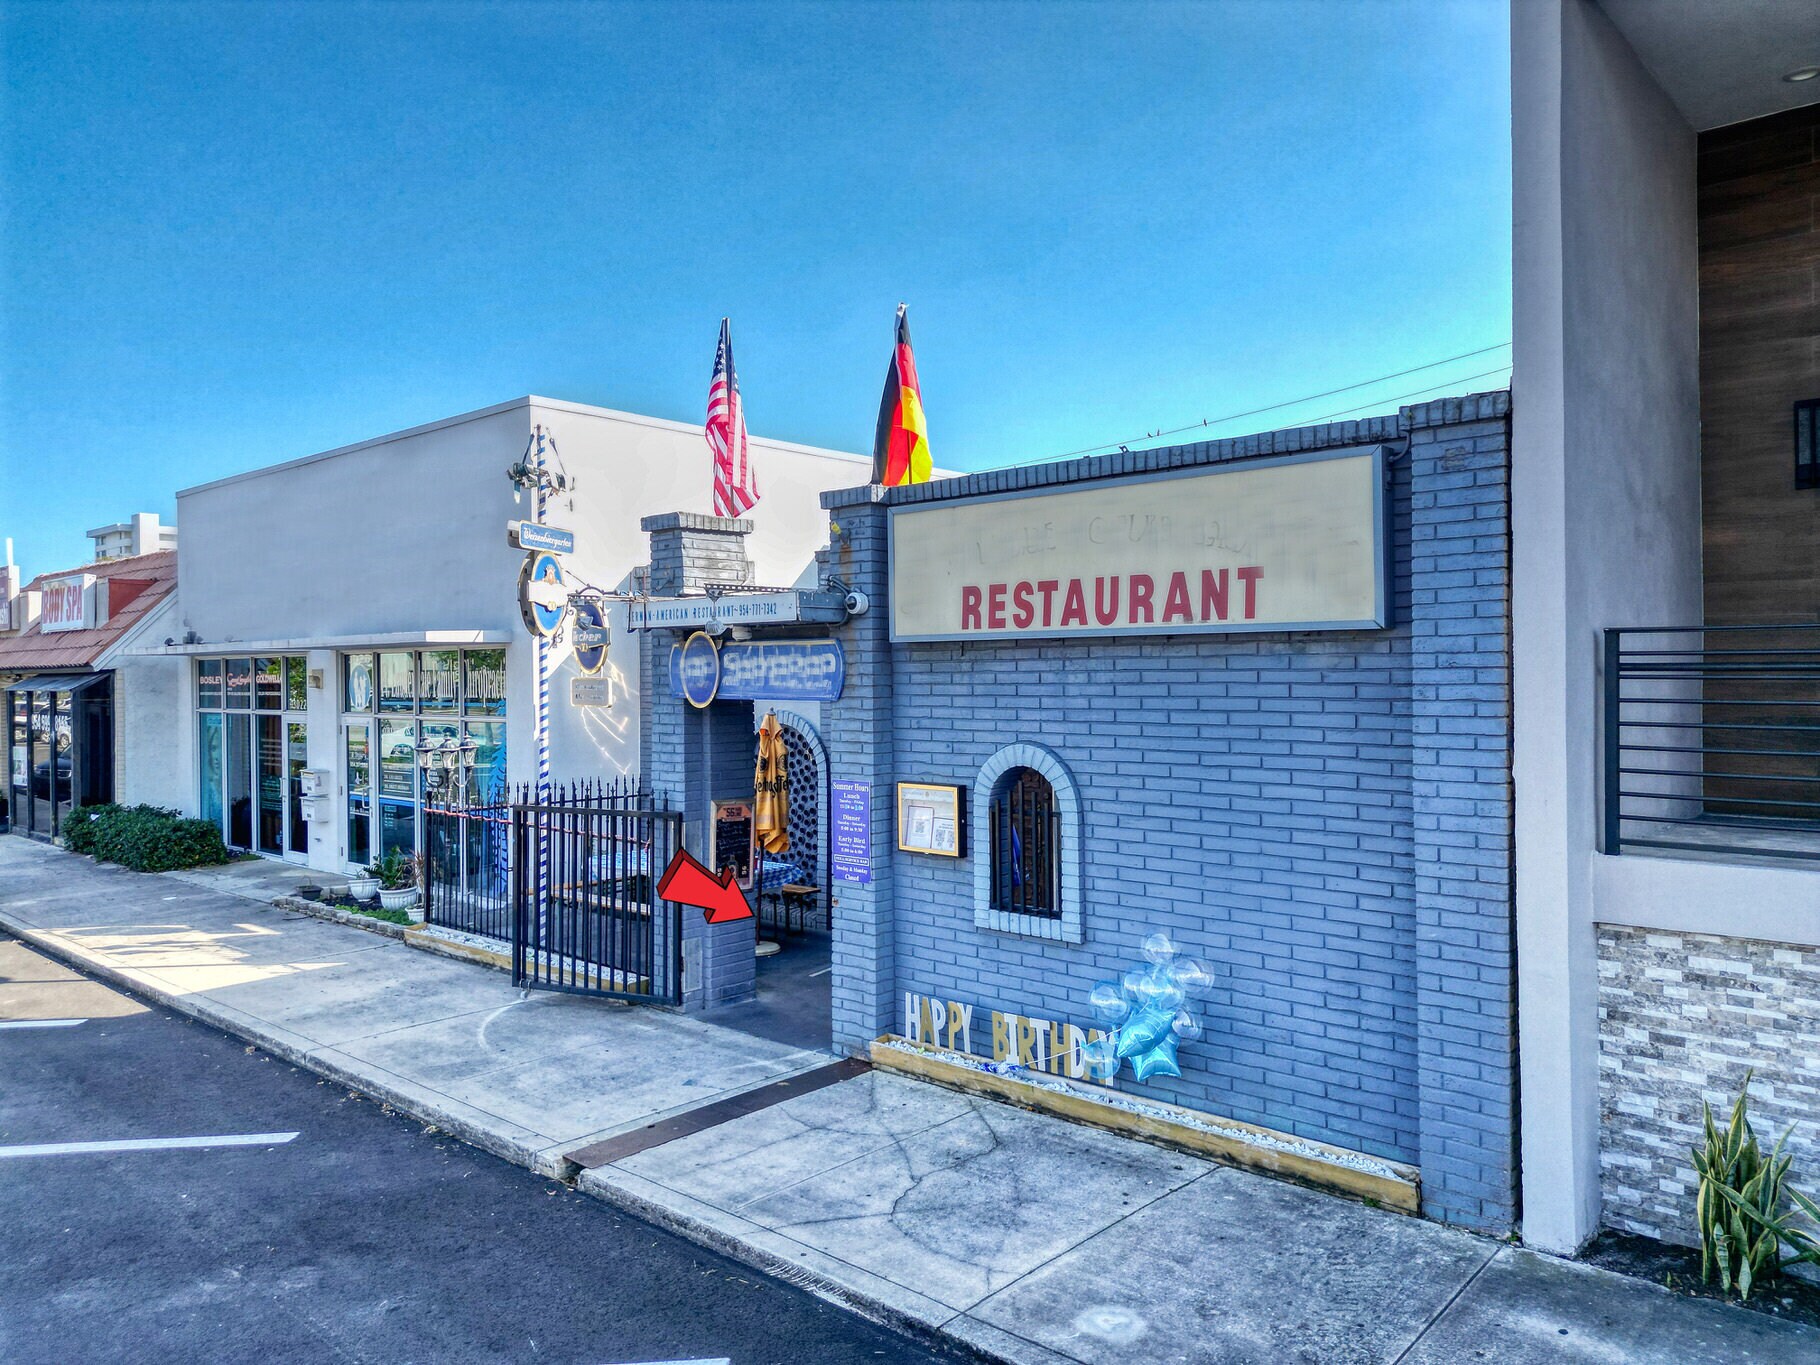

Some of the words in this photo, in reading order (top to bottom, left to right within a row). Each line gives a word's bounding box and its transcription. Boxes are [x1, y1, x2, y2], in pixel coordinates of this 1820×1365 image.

[42, 586, 65, 624] BODY
[66, 584, 82, 622] SPA
[961, 566, 1265, 631] RESTAURANT
[200, 676, 223, 685] BOSLEY
[833, 782, 853, 790] Summer
[854, 784, 869, 792] Hours
[838, 835, 852, 843] Early
[905, 992, 973, 1055] HAPPY
[991, 1010, 1115, 1087] BIRTHDAY
